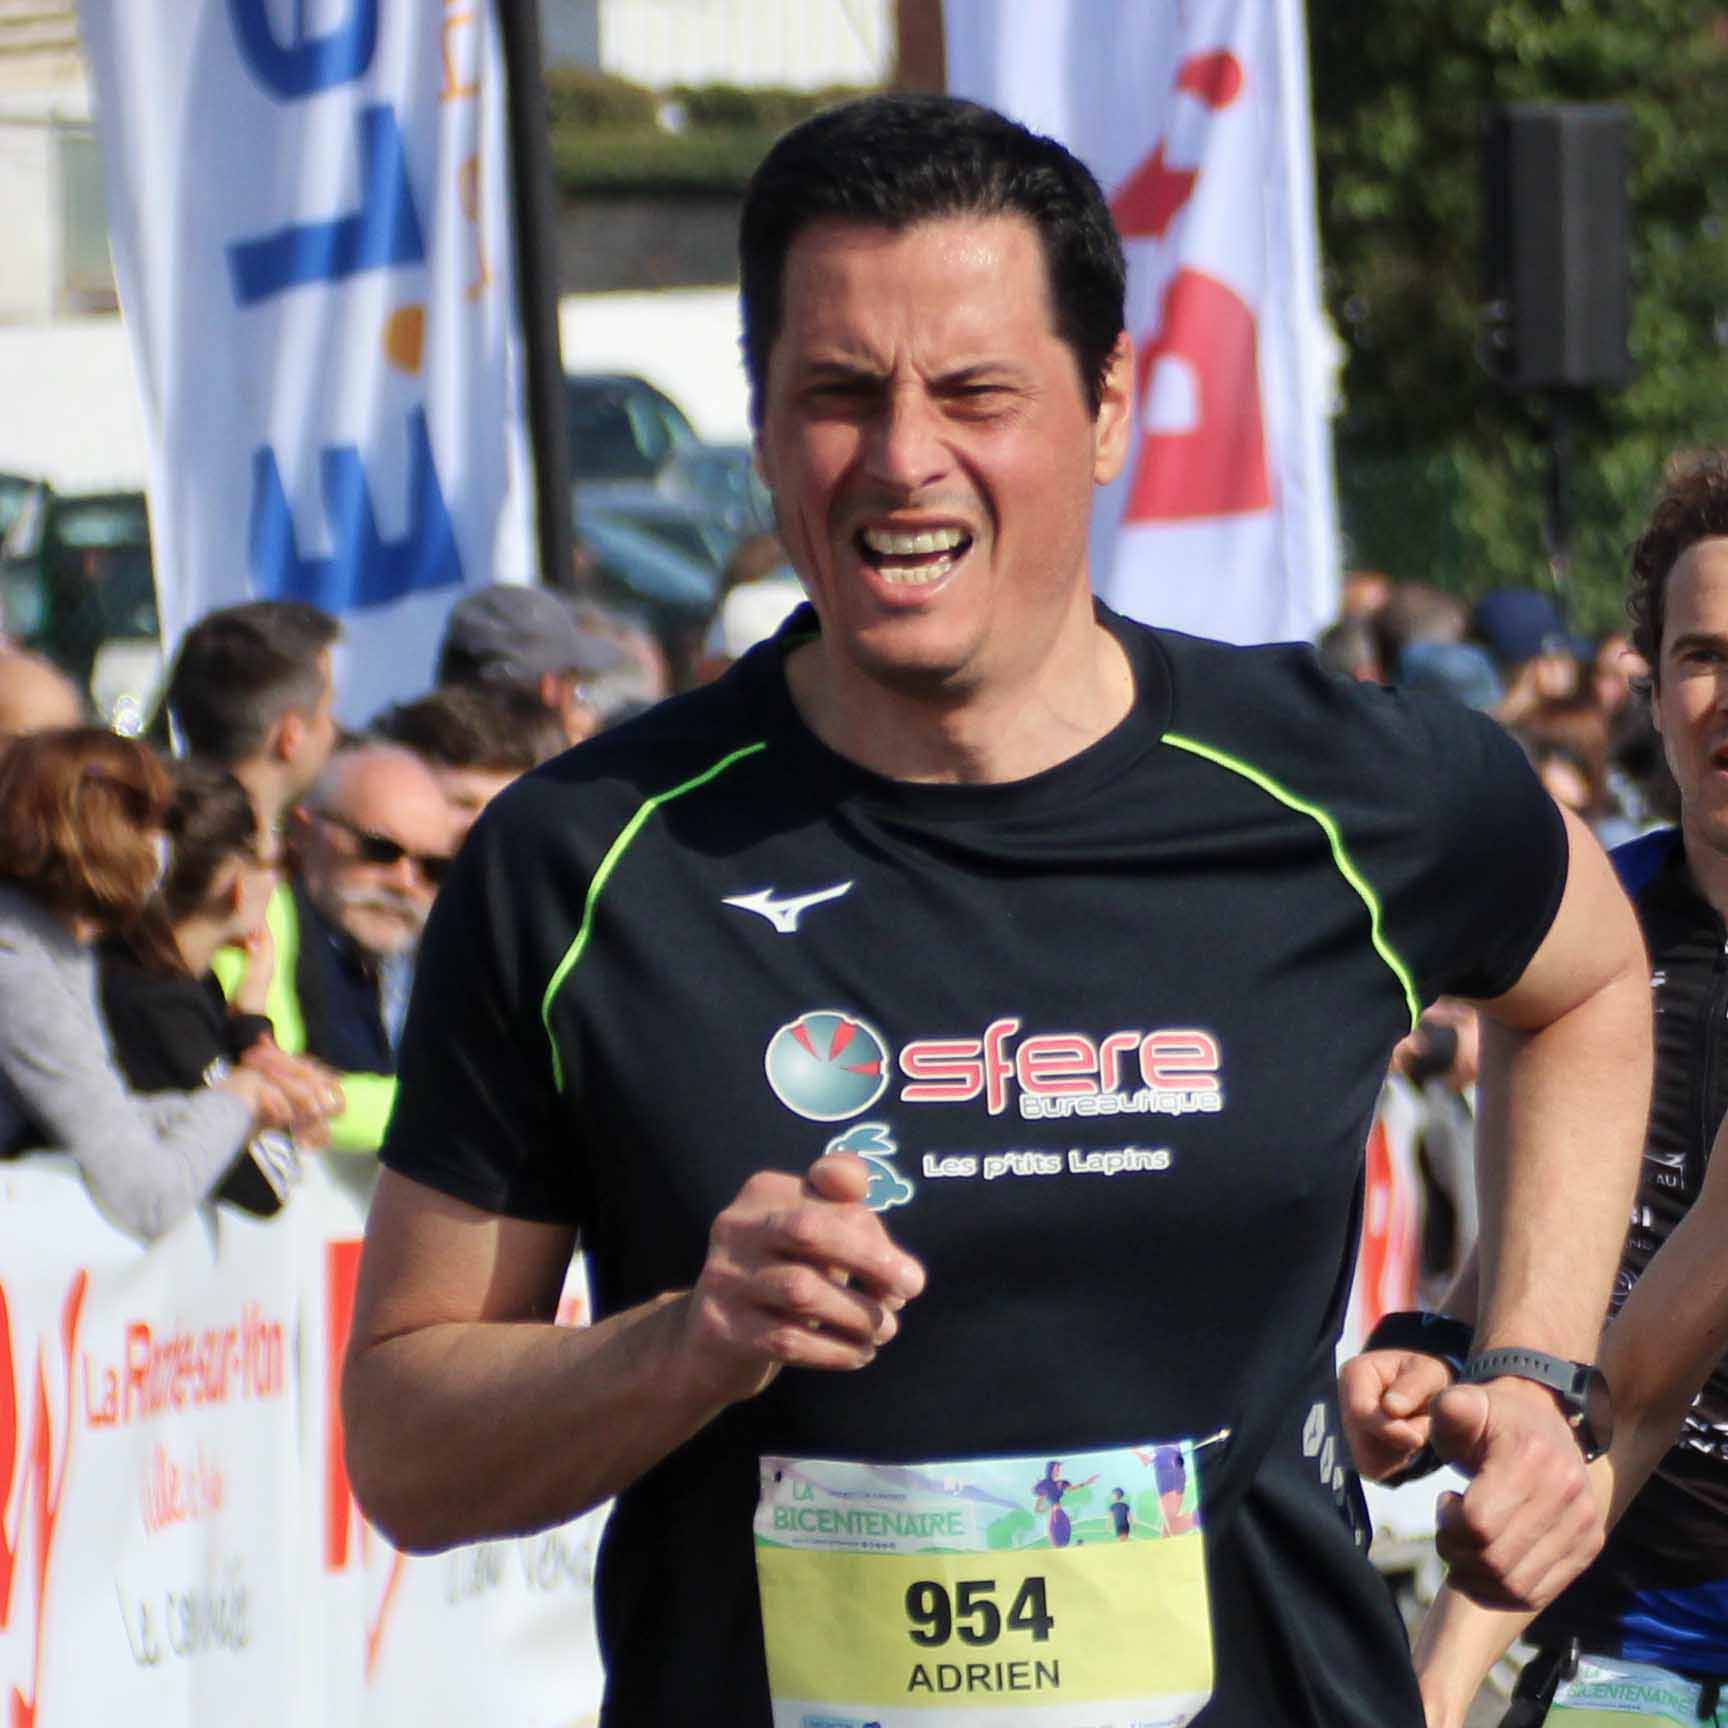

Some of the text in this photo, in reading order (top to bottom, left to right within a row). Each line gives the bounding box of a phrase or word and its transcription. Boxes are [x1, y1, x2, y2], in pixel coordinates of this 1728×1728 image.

[897, 1016, 1222, 1117] sfere
[1019, 1089, 1225, 1119] Bureautique
[922, 1145, 1171, 1181] Les p'tits Lapins
[773, 1507, 965, 1537] BICENTENAIRE
[904, 1576, 1055, 1648] 954
[907, 1658, 1062, 1693] ADRIEN
